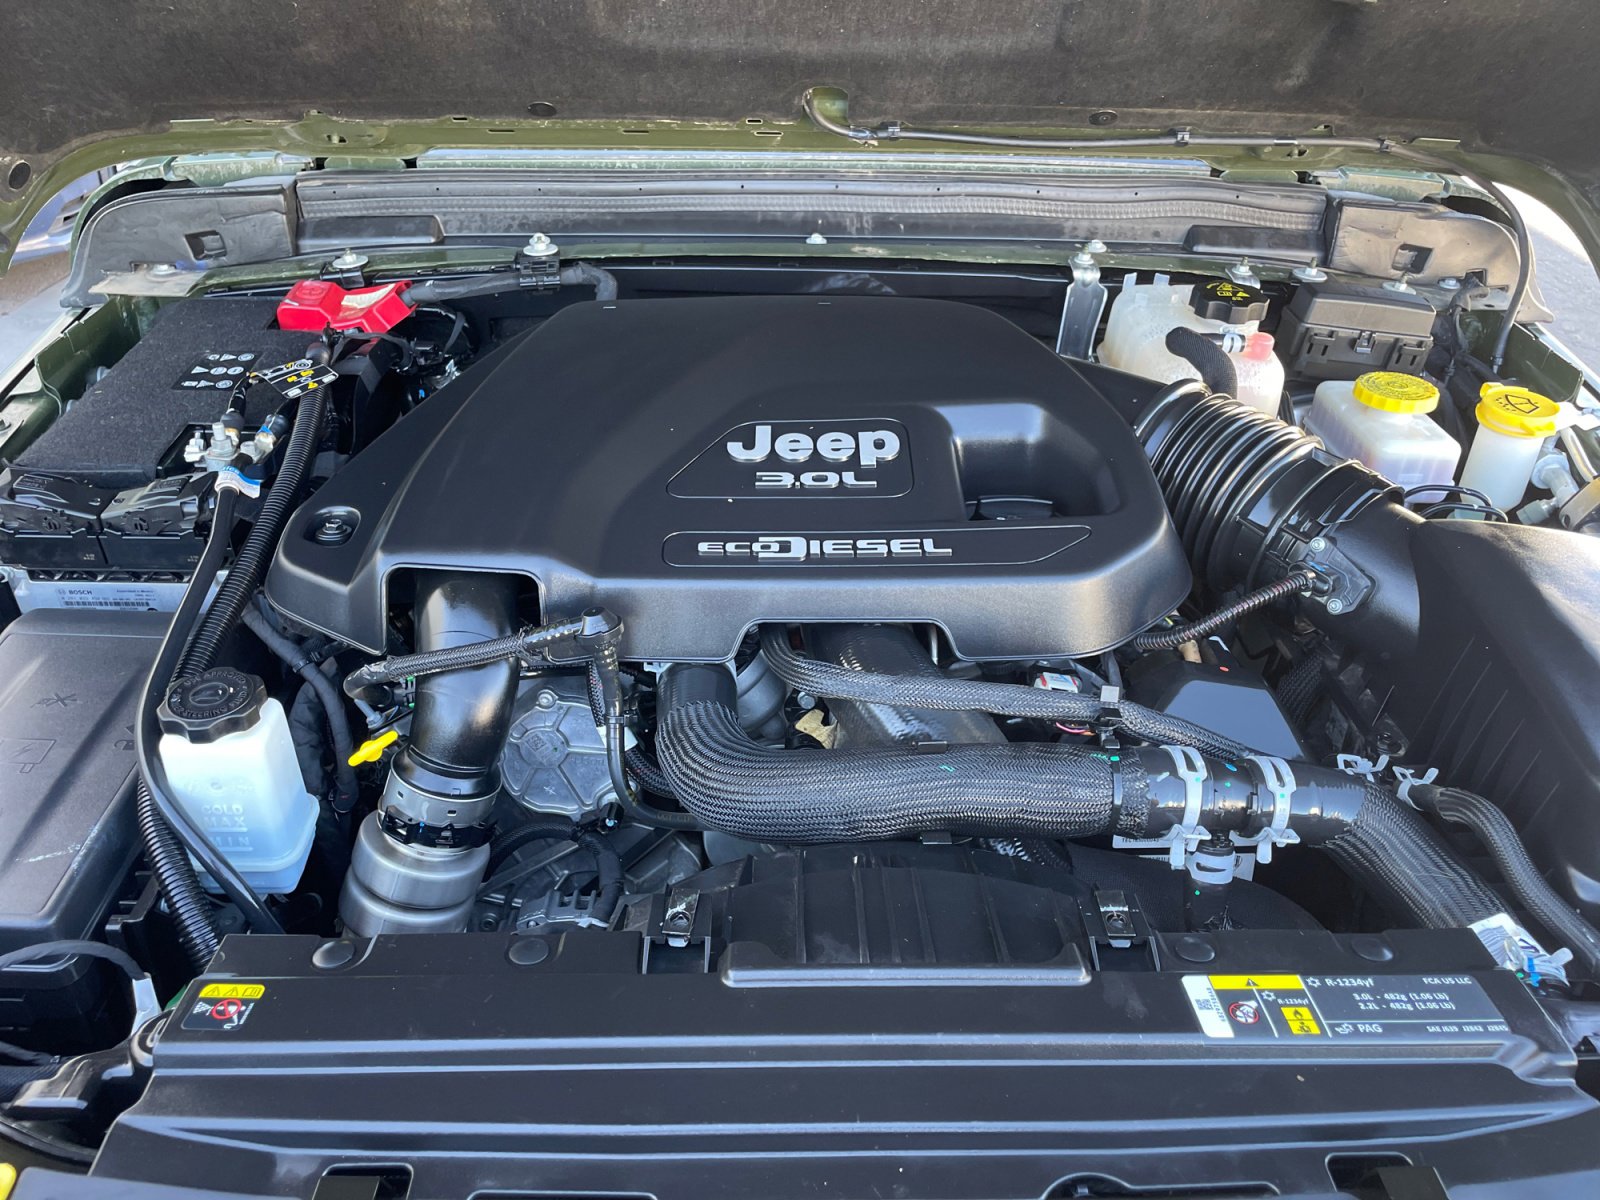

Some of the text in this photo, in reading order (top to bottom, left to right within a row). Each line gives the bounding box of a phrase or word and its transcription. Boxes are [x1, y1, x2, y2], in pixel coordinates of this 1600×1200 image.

[726, 425, 901, 468] Jeep
[754, 471, 877, 489] 3.0L
[182, 706, 228, 717] STEERING
[201, 804, 243, 815] COLD
[203, 816, 246, 827] MAX
[209, 836, 250, 846] MIN
[1324, 977, 1375, 988] R-1234yf
[1422, 977, 1473, 985] FCA US LLC
[1352, 993, 1374, 1001] 3.0L
[1383, 993, 1408, 1002] 482g
[1357, 1002, 1380, 1010] 2.2L
[1389, 1002, 1414, 1011] 482g
[1357, 1023, 1384, 1033] PAG
